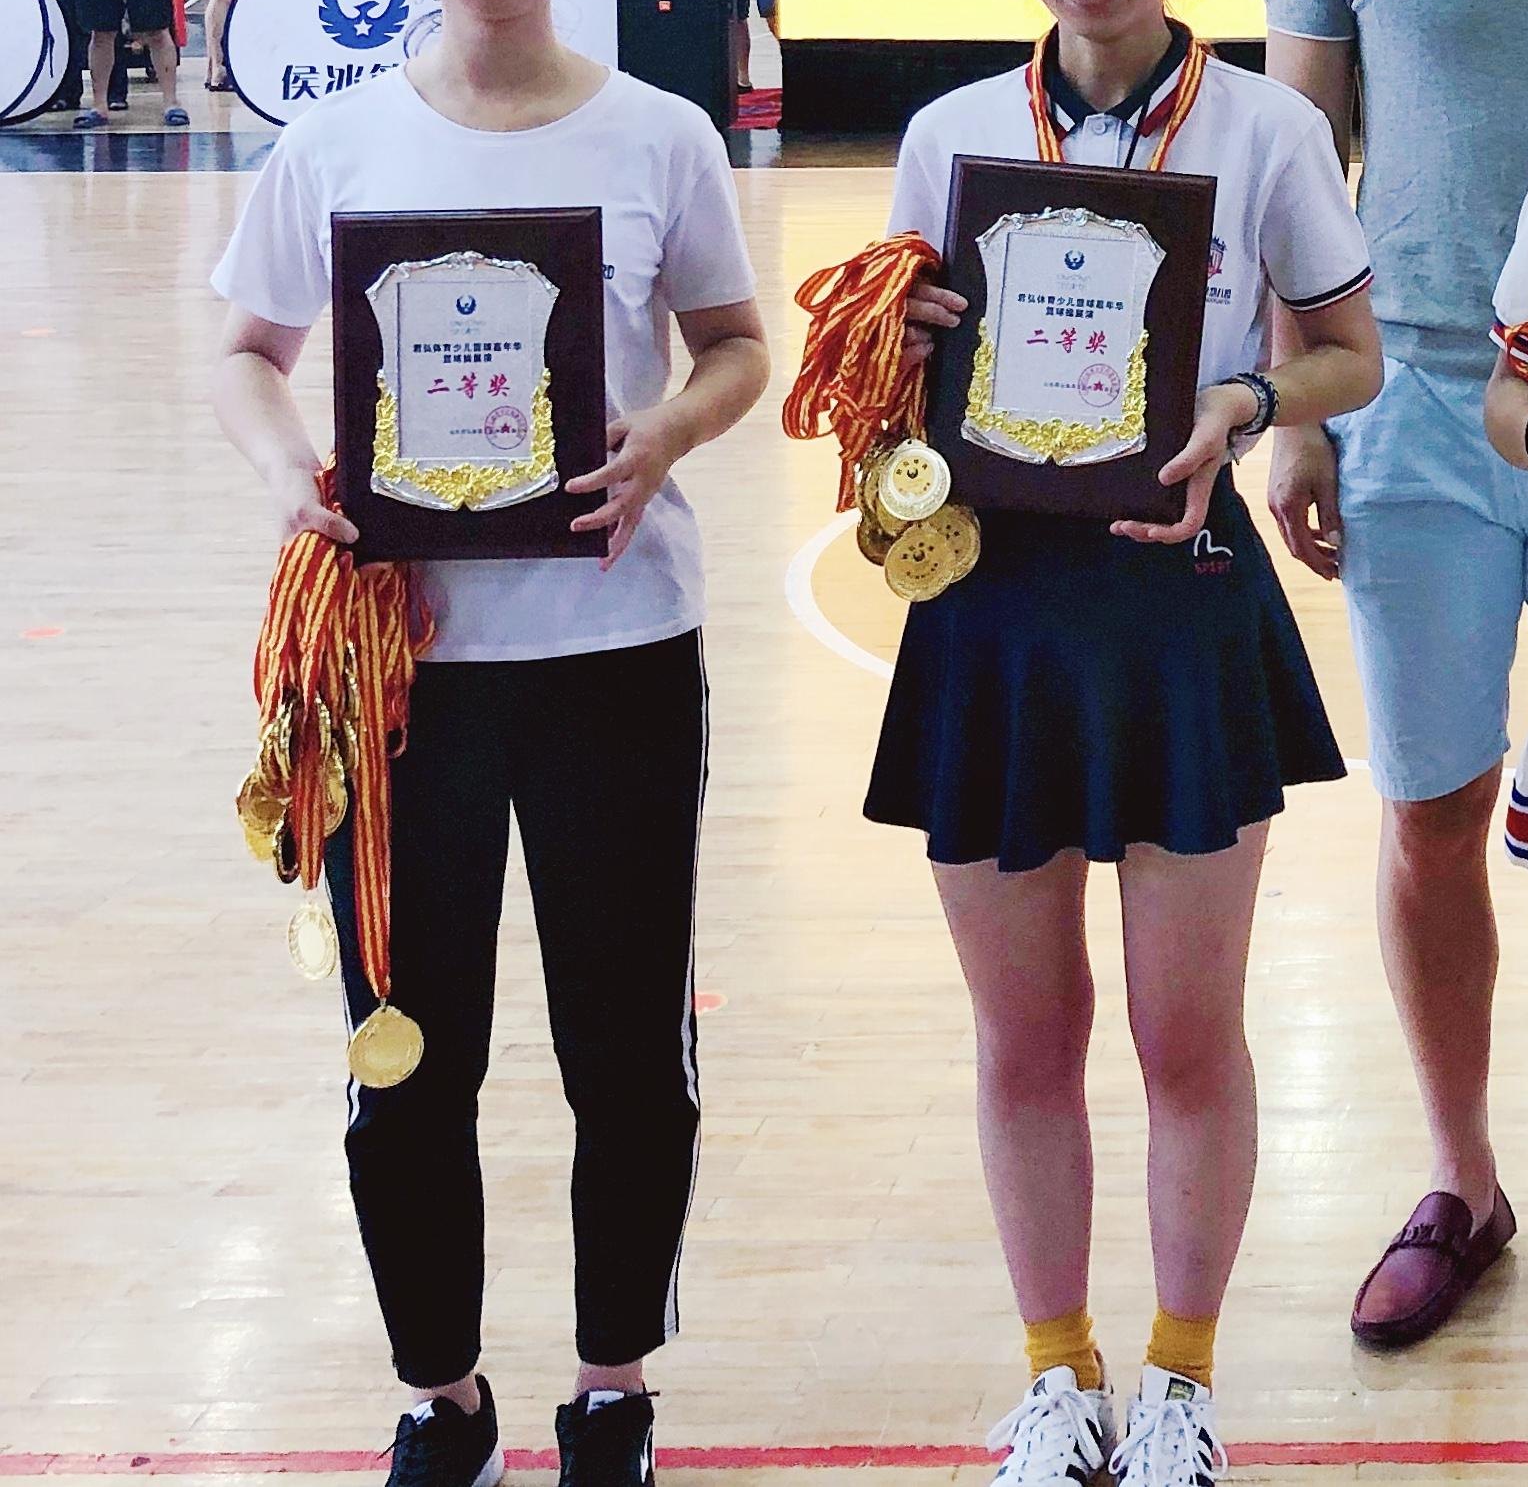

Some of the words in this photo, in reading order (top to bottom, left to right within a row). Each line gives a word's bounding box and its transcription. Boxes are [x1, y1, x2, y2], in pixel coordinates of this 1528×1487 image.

[1026, 327, 1108, 354] 二等奖
[427, 372, 511, 399] 二等奖
